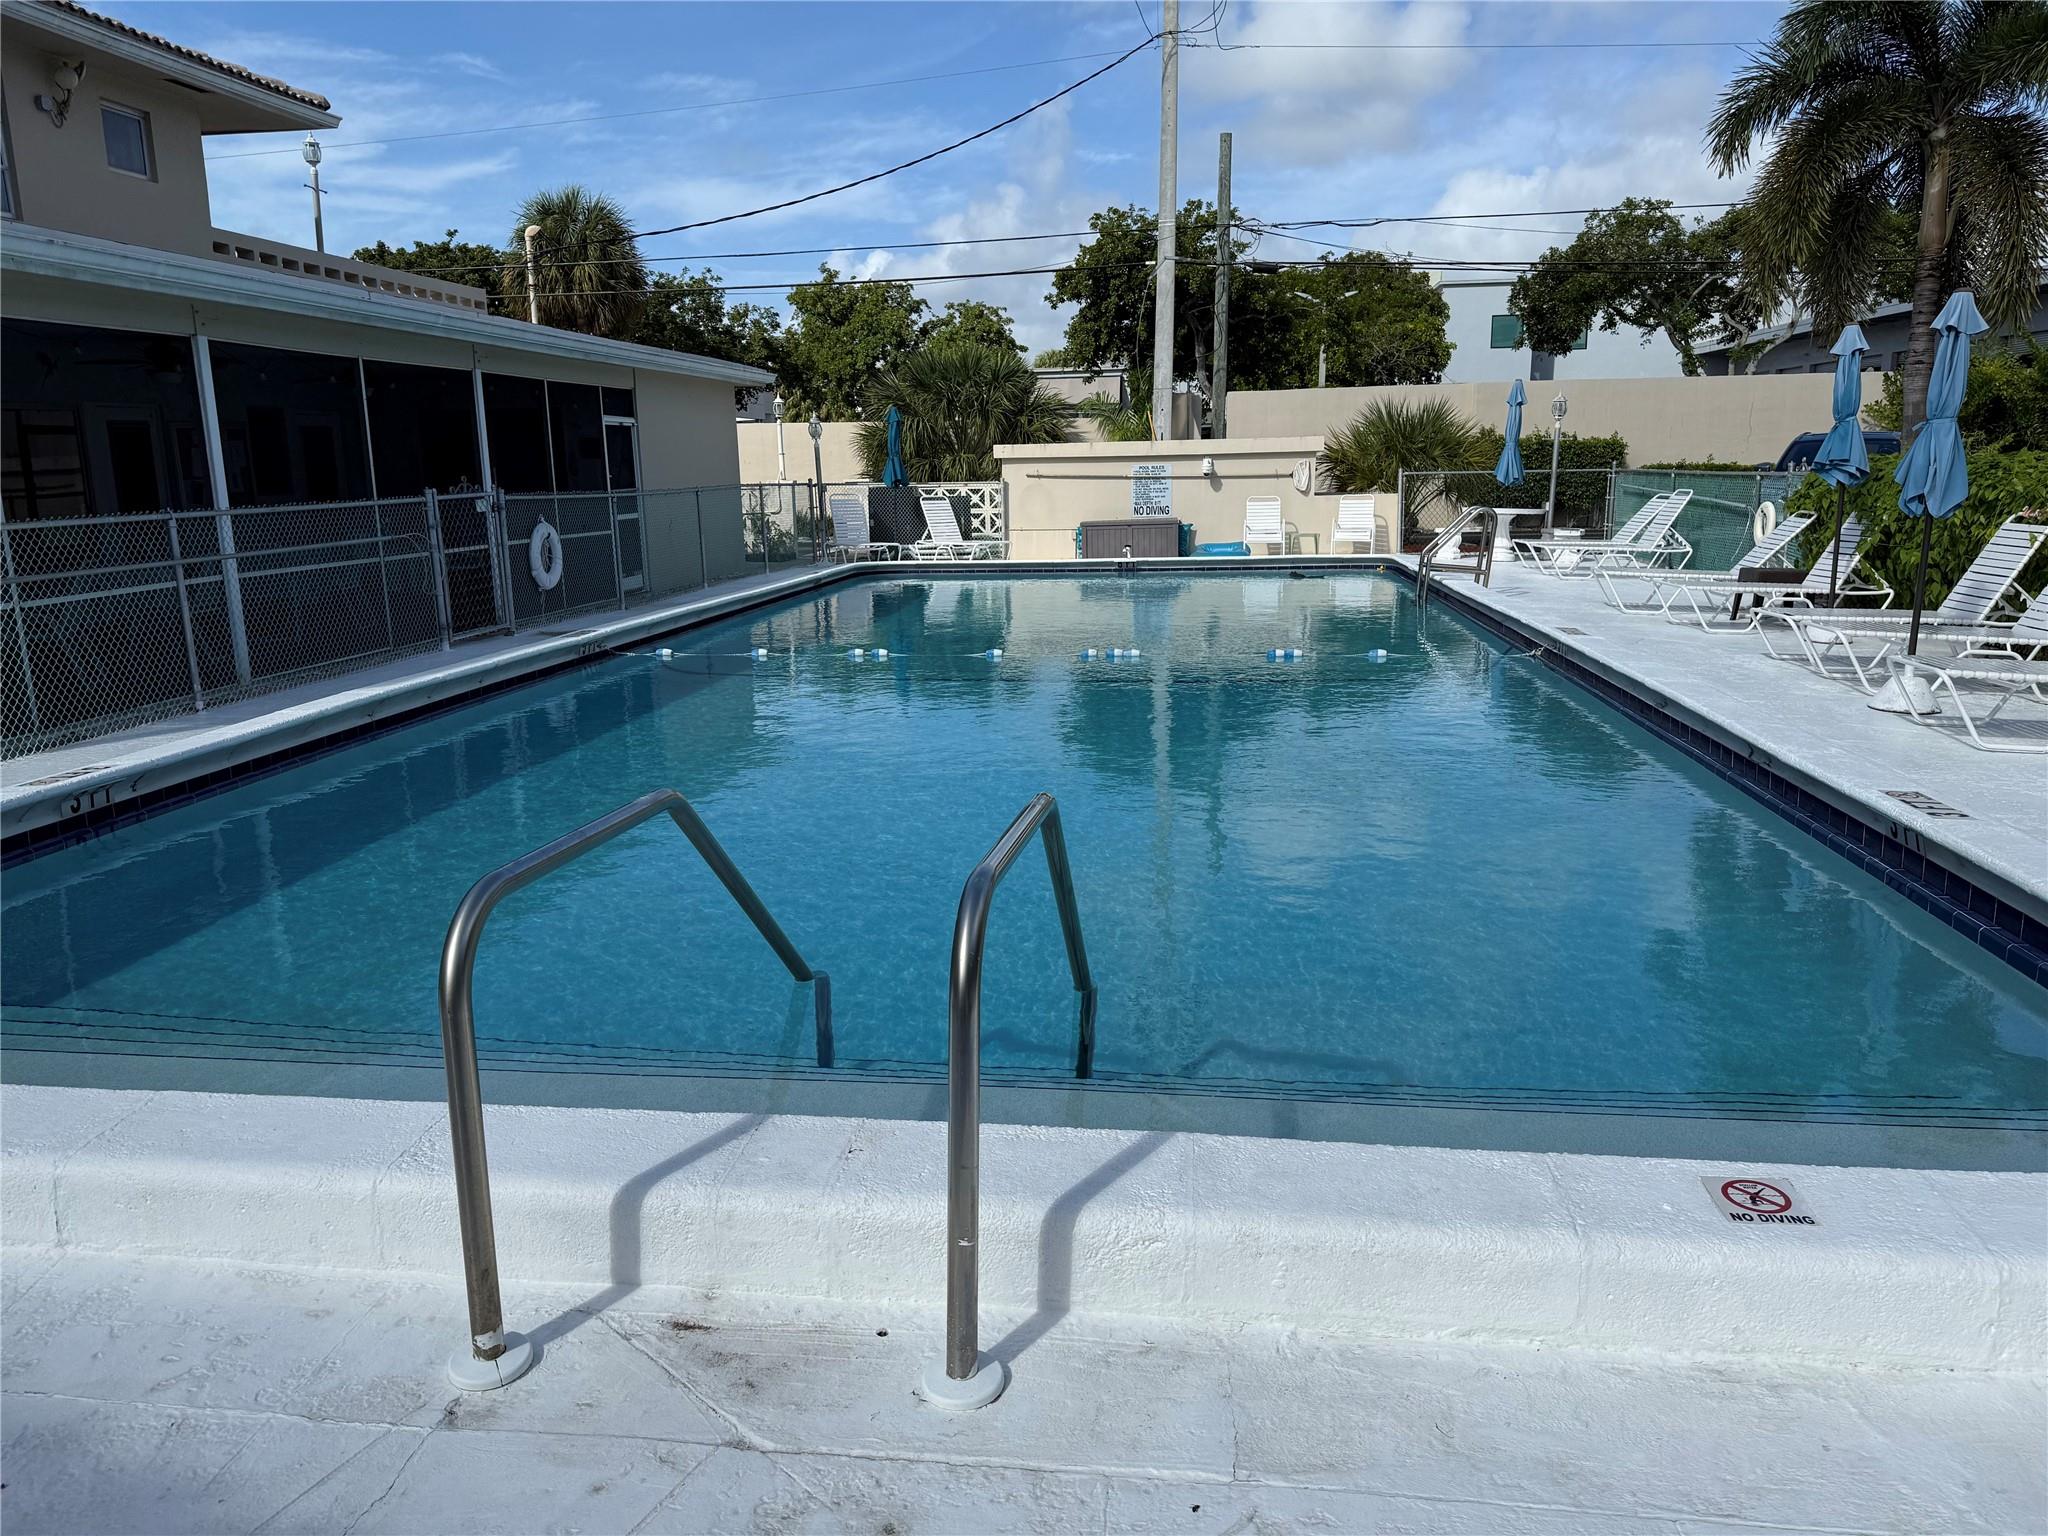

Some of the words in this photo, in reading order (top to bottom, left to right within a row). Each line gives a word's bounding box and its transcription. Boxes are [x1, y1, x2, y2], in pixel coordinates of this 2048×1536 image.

[1133, 505, 1144, 515] NO
[1145, 505, 1170, 515] DIVING
[1729, 1212, 1754, 1222] NO
[1757, 1213, 1815, 1225] DIVING
